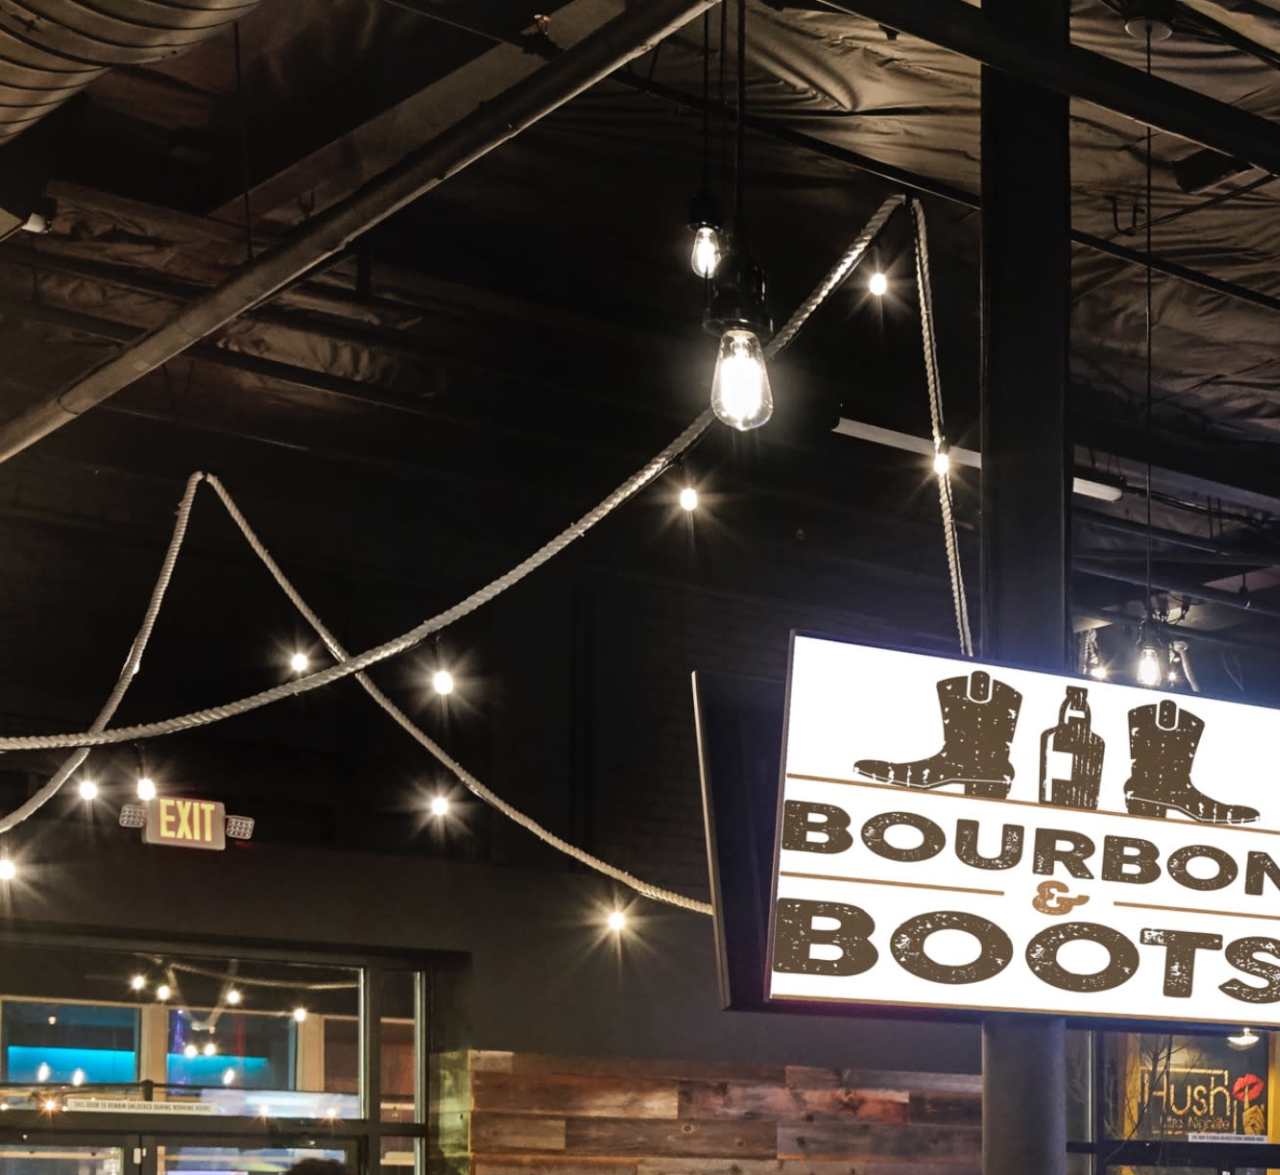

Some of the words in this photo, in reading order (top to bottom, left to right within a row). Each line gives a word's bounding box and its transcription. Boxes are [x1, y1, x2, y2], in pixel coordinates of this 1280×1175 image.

[159, 799, 216, 842] EXIT
[1031, 880, 1091, 916] &
[1142, 1072, 1232, 1116] Hush
